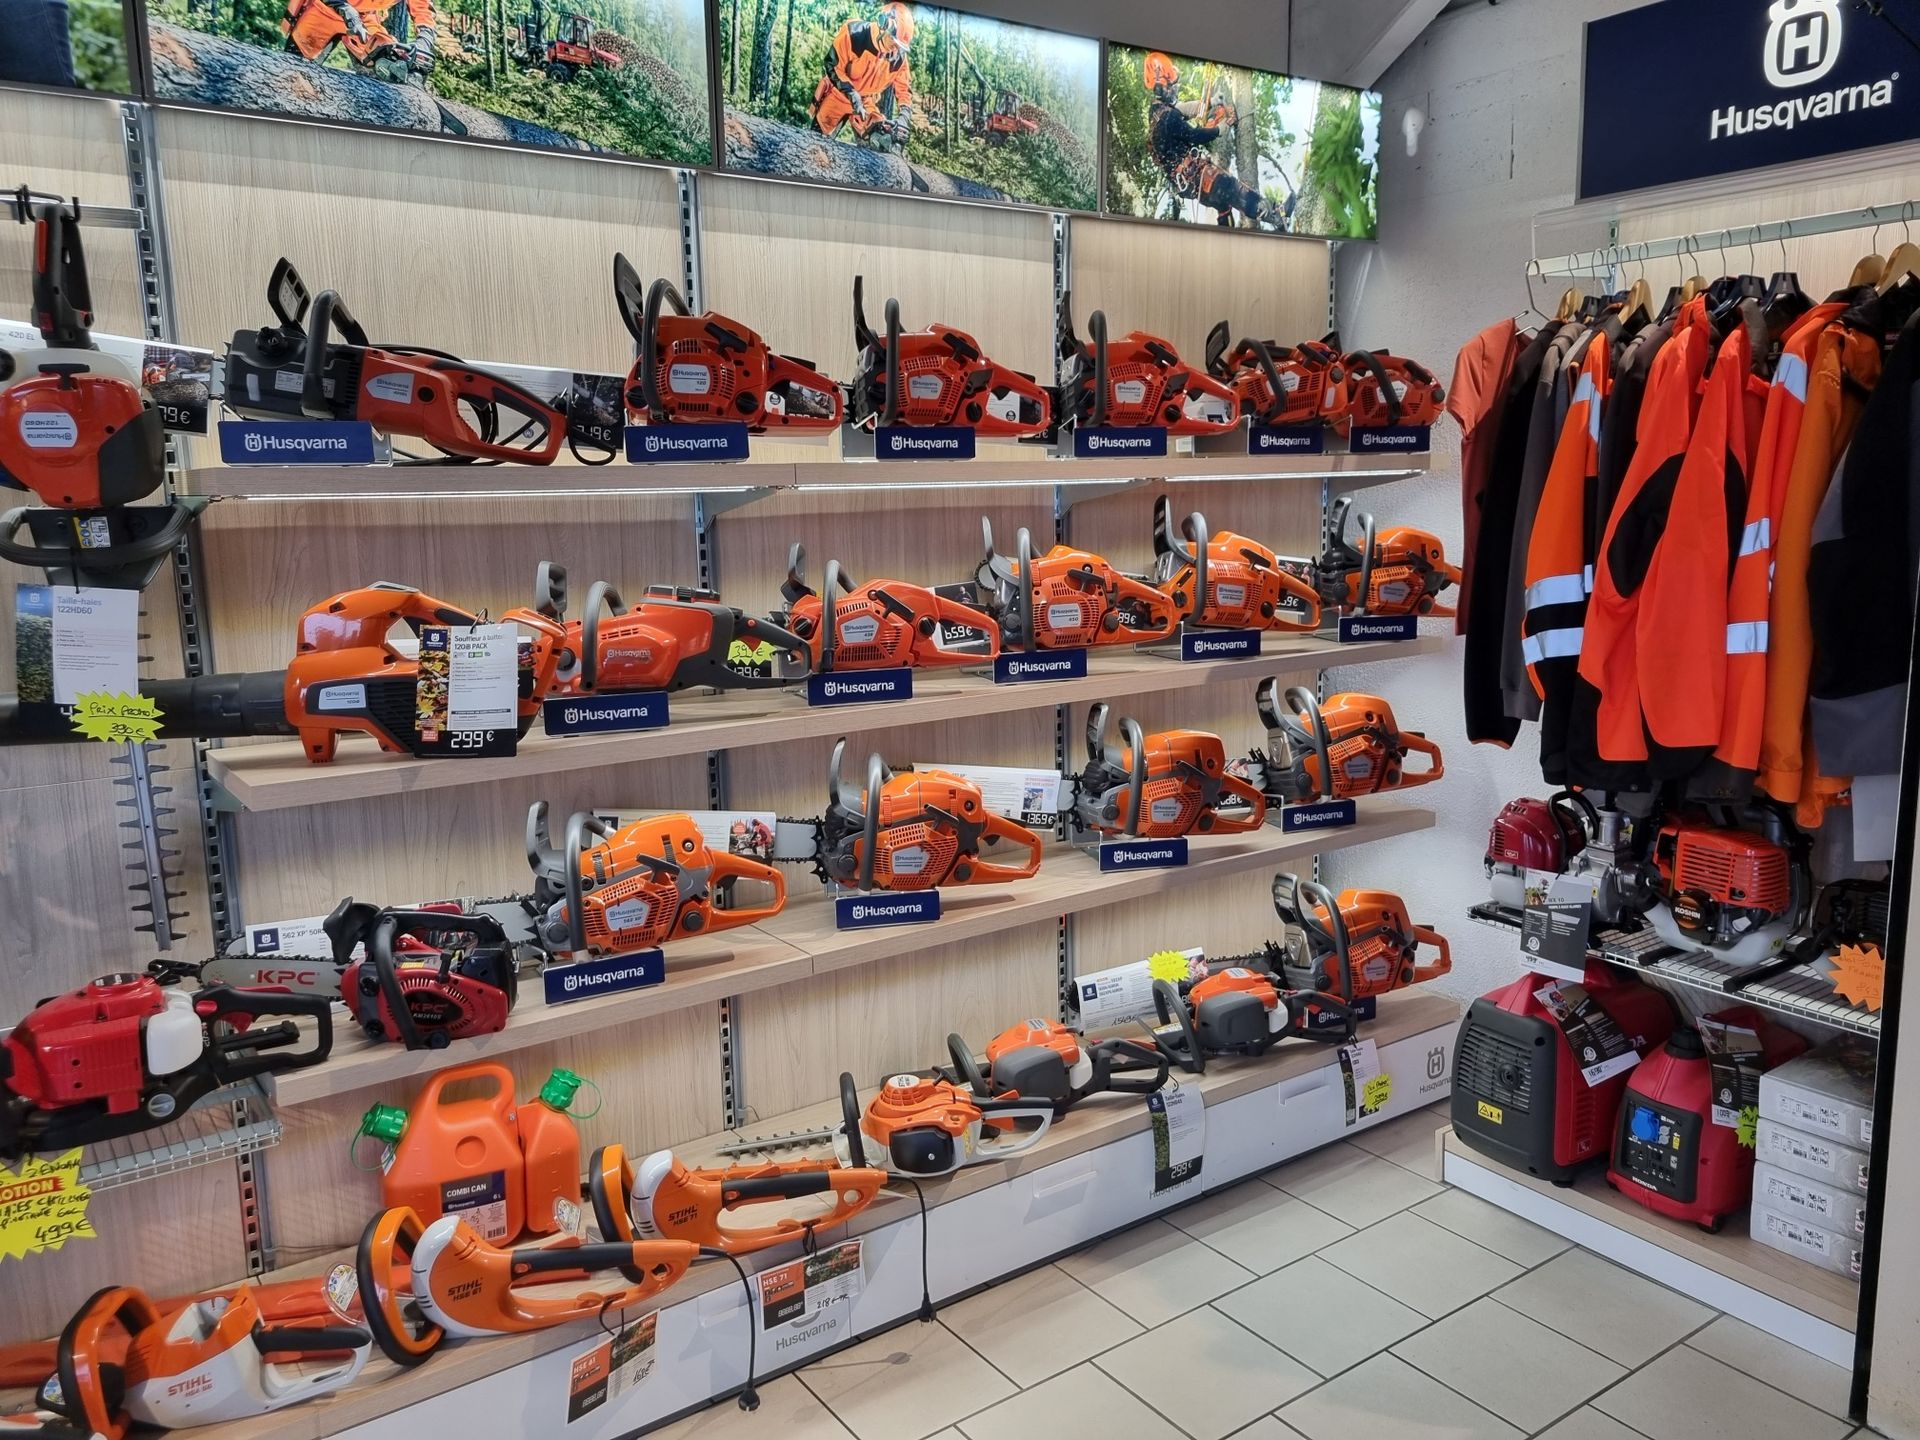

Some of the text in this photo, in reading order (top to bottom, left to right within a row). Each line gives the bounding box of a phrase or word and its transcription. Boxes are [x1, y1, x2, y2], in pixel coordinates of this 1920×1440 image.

[1709, 79, 1894, 140] Husqvarna
[263, 435, 347, 452] Husqvarna
[661, 437, 728, 451] Husqvarna
[903, 437, 958, 452] Husqvarna
[1099, 437, 1151, 449] Husqvarna
[1269, 436, 1311, 448] Husqvarna
[1372, 434, 1416, 446] Husqvarna
[57, 606, 92, 615] 122HD60
[1361, 623, 1403, 636] Husqvarna
[1203, 640, 1248, 652] Husqvarna
[1019, 661, 1071, 674] Husqvarna
[837, 681, 895, 695] Husqvarna
[579, 707, 648, 721] Husqvarna
[1302, 811, 1343, 823] Husqvarna
[1124, 850, 1173, 862] Husqvarna
[865, 903, 922, 919] Husqvarna
[282, 931, 296, 940] 562
[257, 970, 315, 986] KPC
[578, 966, 644, 986] Husqvarna
[410, 1002, 445, 1014] KPC
[446, 1183, 487, 1198] COMBI CAN
[1632, 1176, 1657, 1191] HONDA
[668, 1204, 698, 1222] STIHL
[689, 1213, 698, 1221] 71
[448, 1277, 482, 1297] STIHL
[762, 1273, 788, 1287] HSE 71
[776, 1317, 837, 1351] Husqvarna
[168, 1374, 212, 1397] STIHL
